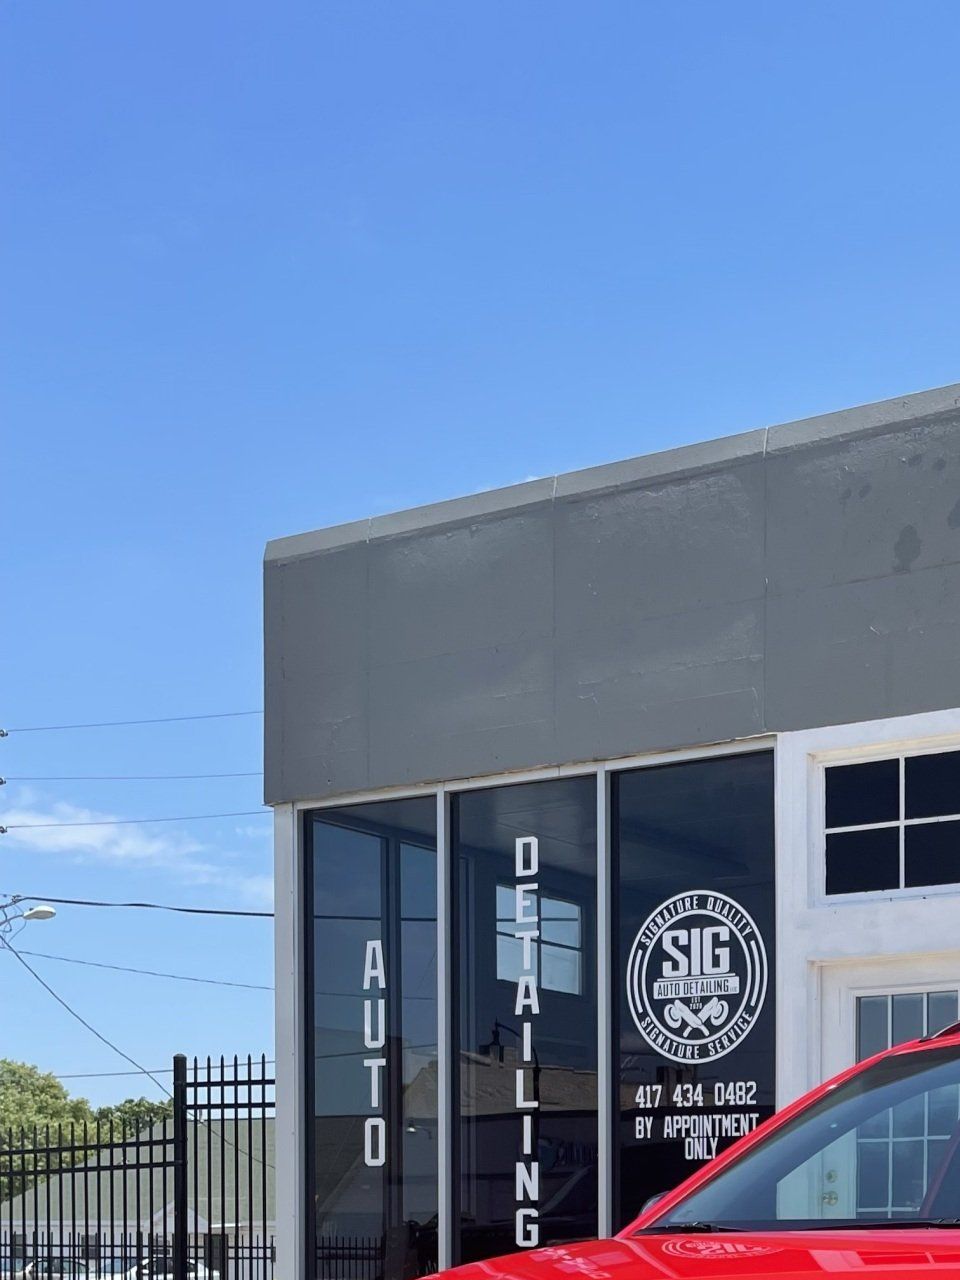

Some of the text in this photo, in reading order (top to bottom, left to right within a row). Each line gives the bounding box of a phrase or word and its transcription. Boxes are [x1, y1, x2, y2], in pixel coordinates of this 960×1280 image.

[641, 896, 753, 946] SIGNATURE QUALITY
[662, 926, 730, 978] SIG
[657, 982, 680, 997] AUTO
[684, 979, 729, 996] DETAILING
[363, 939, 387, 1167] AUTO
[514, 836, 540, 1248] DETAILING
[641, 1010, 753, 1059] SIGNATURE SERVICE
[635, 1081, 757, 1108] 417 434 0482
[635, 1113, 759, 1139] BY APPOINTMENT
[685, 1137, 718, 1160] ONLY
